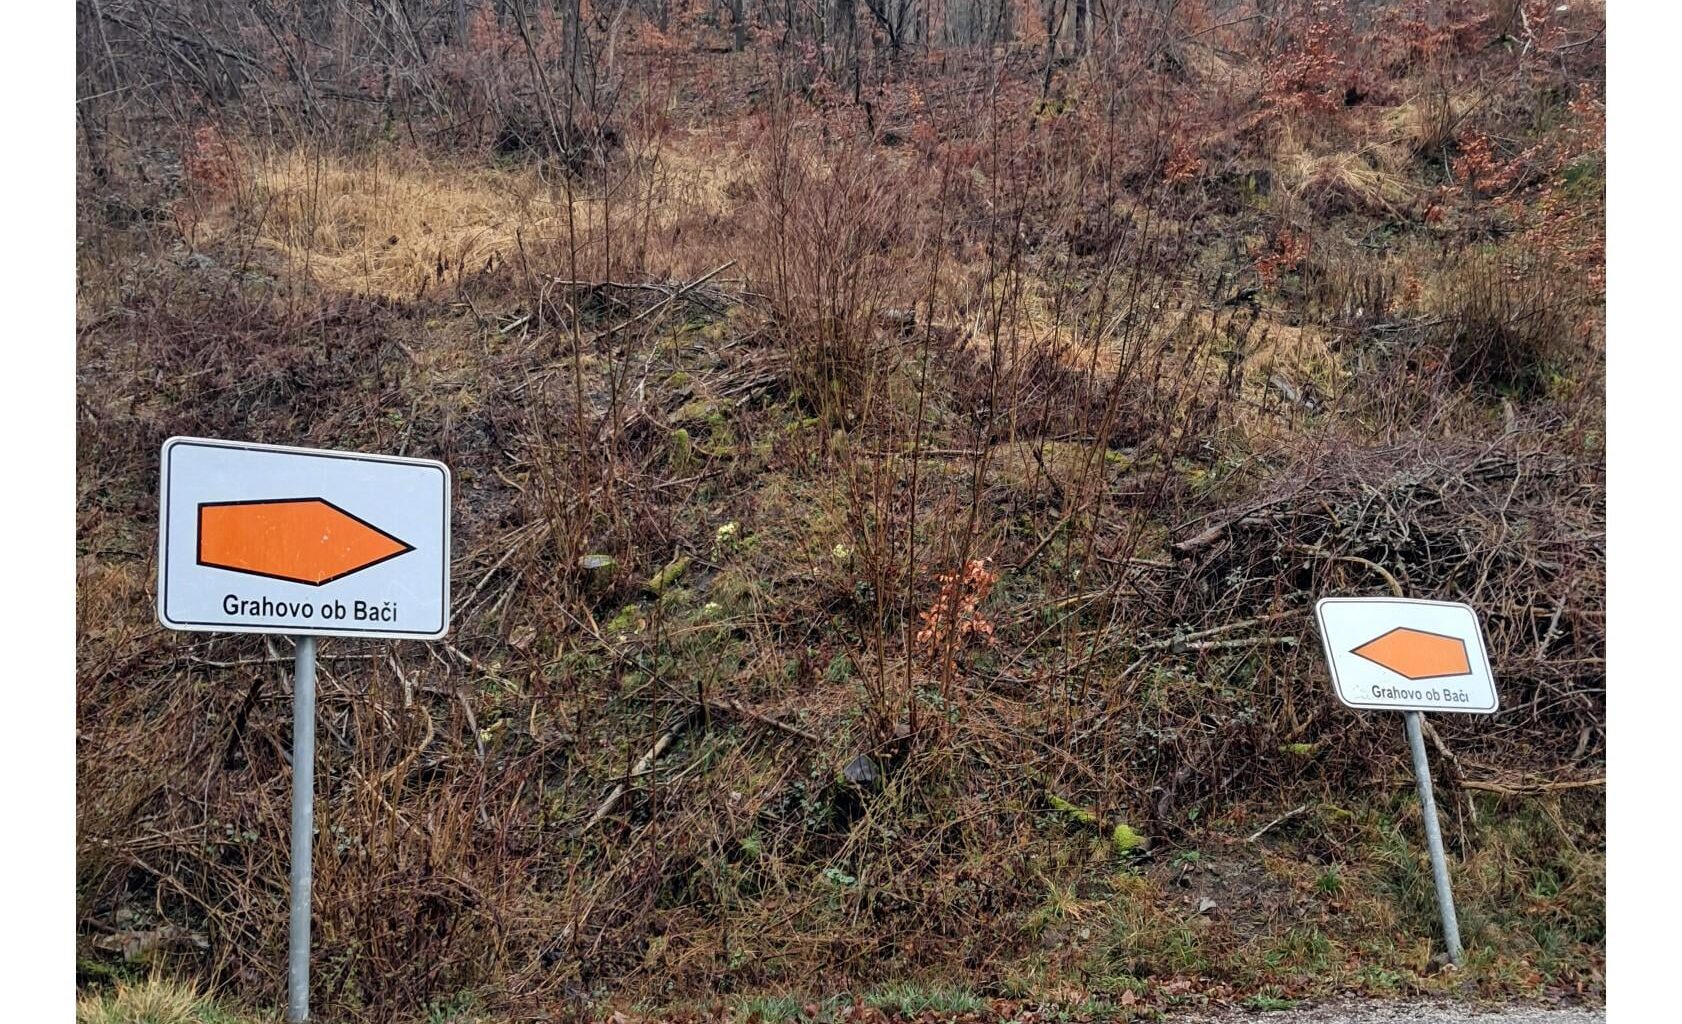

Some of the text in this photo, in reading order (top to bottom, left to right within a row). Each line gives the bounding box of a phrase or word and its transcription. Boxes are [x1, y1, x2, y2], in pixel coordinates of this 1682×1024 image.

[222, 594, 398, 622] Grahovo ob Bači
[1371, 685, 1470, 703] Grahovo ob Bači
